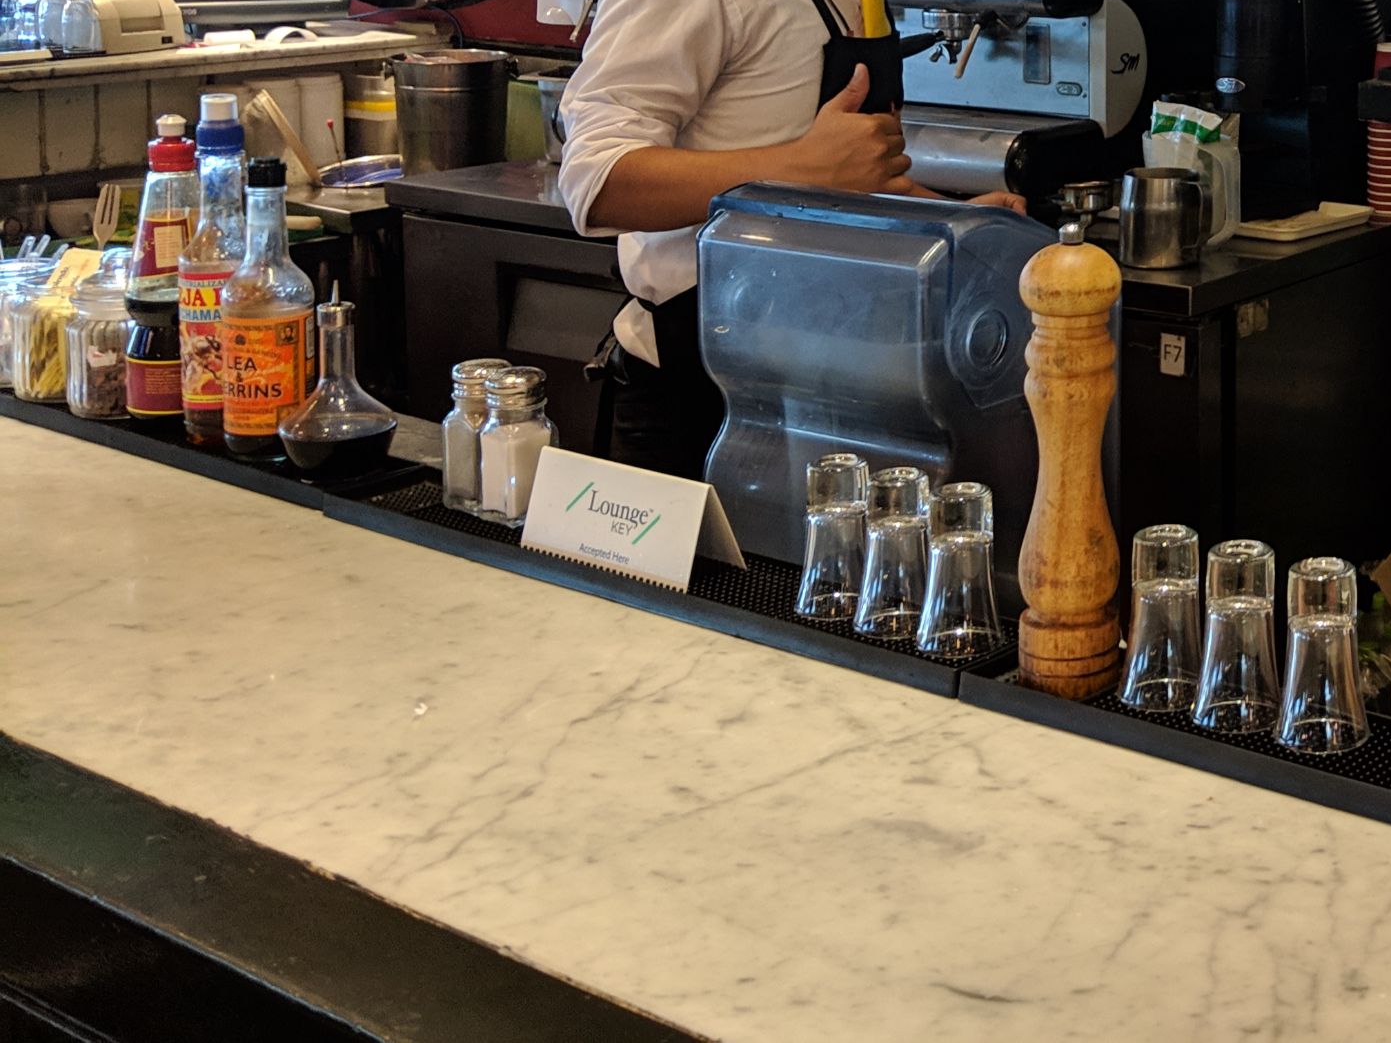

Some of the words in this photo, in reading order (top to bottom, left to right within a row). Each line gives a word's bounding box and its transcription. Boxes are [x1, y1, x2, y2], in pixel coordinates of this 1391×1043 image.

[1164, 344, 1182, 363] F7
[227, 356, 257, 371] LEA
[588, 489, 649, 529] Lounge
[610, 520, 633, 536] KEY
[579, 543, 611, 560] Accepted
[612, 552, 630, 564] Here
